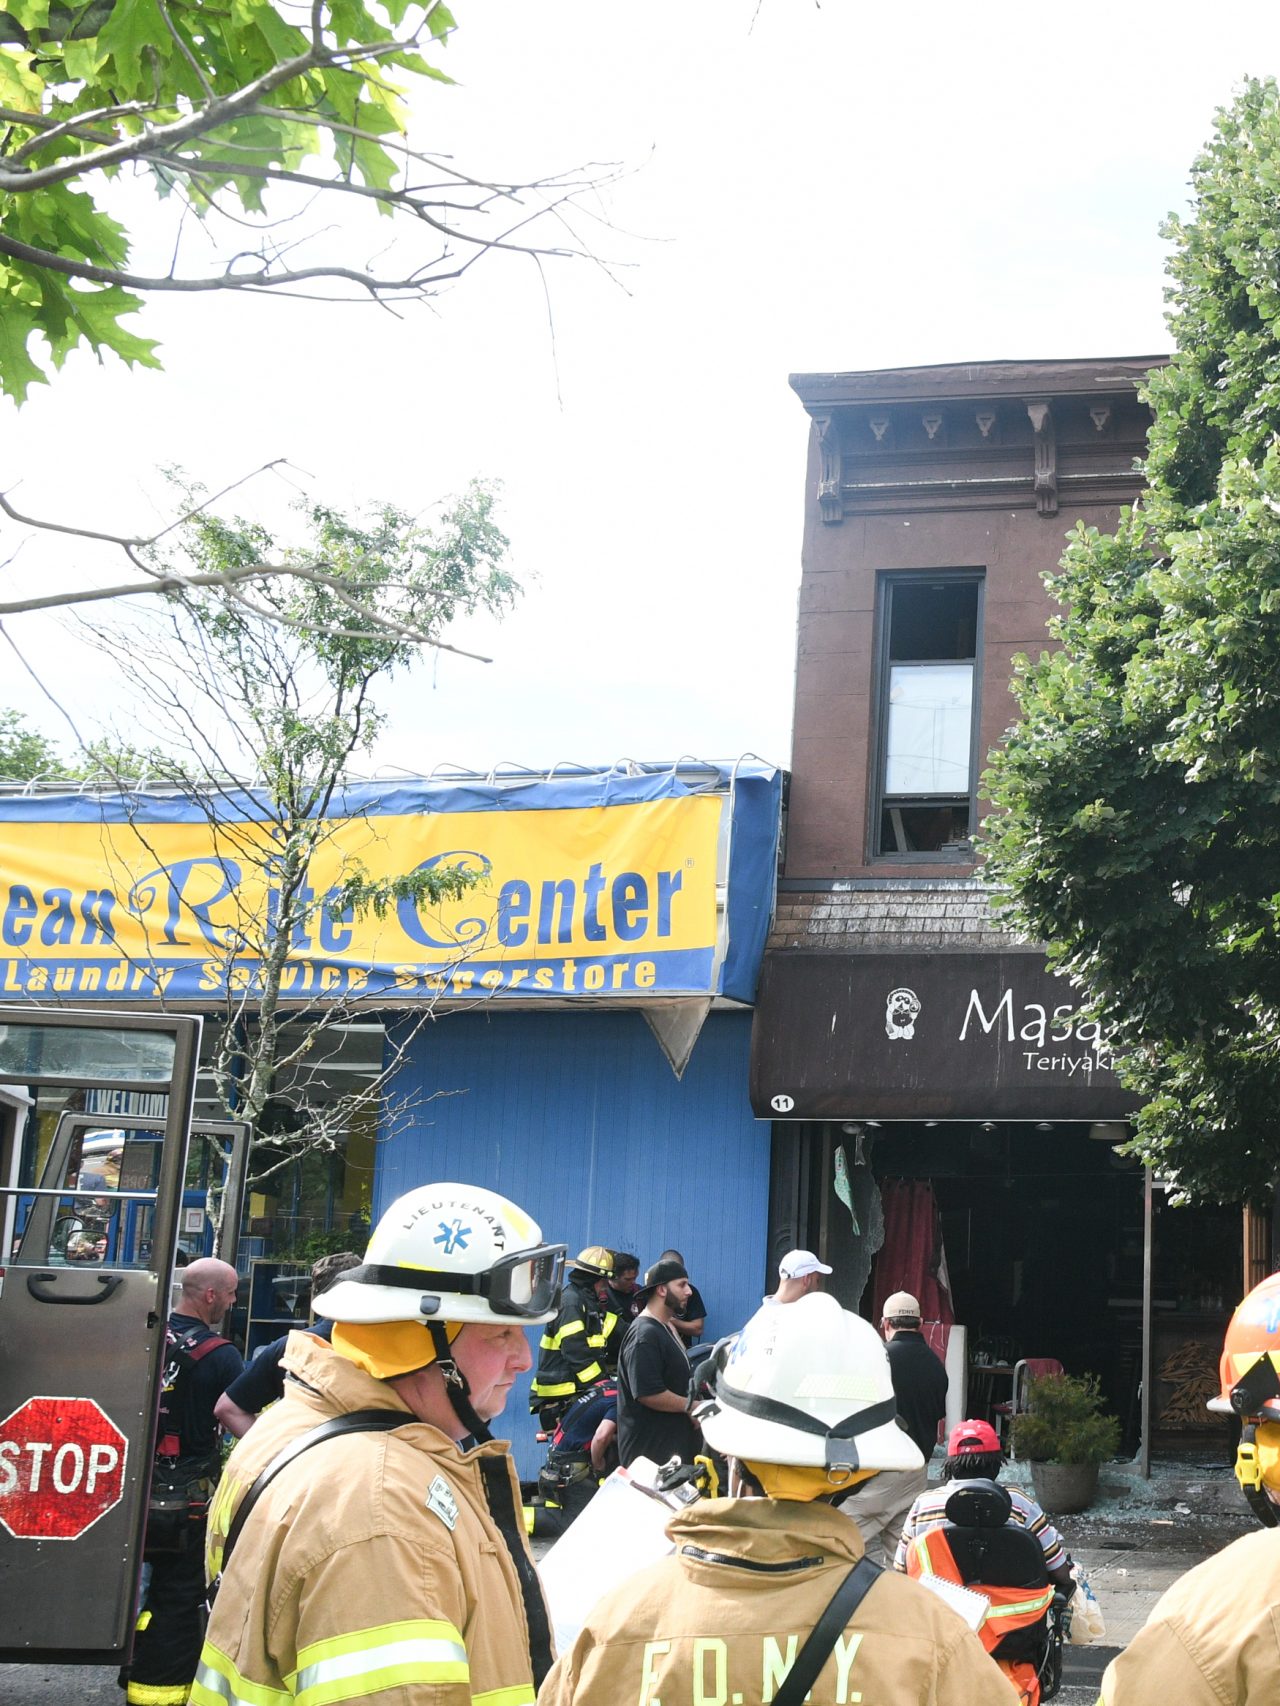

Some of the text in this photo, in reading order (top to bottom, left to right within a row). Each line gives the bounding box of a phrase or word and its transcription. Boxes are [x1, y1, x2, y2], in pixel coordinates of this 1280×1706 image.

[396, 850, 683, 949] Center
[4, 960, 175, 996] Laundry
[395, 959, 656, 994] Superstore
[1022, 1052, 1116, 1077] Teriyaki
[773, 1097, 790, 1109] 11
[402, 1200, 507, 1251] LIEUTENANT
[0, 1440, 119, 1495] STOP
